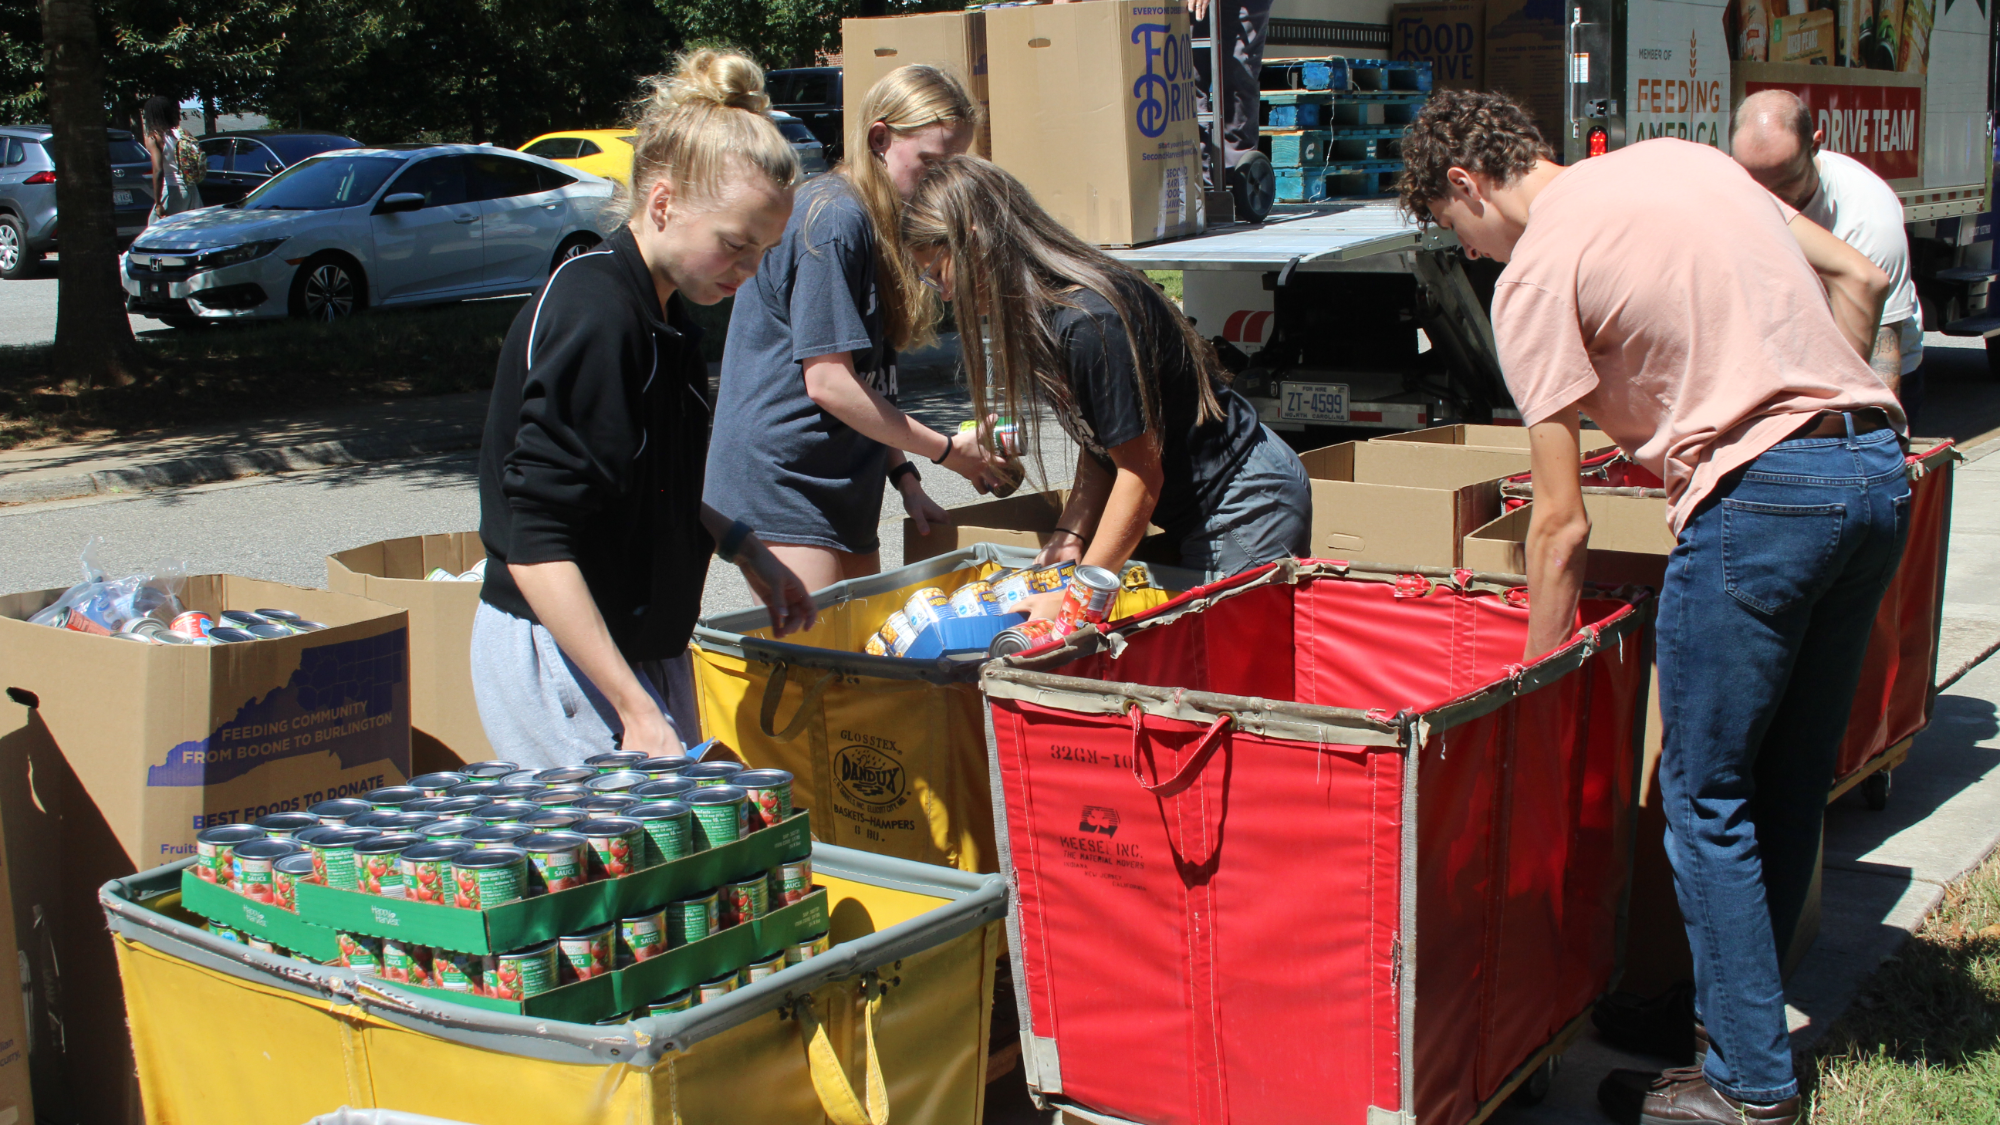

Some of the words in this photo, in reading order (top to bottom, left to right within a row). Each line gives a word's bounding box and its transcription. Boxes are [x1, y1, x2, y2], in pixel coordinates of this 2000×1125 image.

[1397, 17, 1474, 54] FOOD
[1131, 23, 1192, 82] FOOD
[1638, 48, 1662, 61] MEMBER
[1663, 49, 1672, 61] OF
[1133, 73, 1196, 138] DRIVE
[1637, 78, 1720, 113] FEEDING
[1818, 109, 1869, 153] DRIVE
[1872, 109, 1916, 152] TEAM
[1287, 391, 1342, 414] ZT-4599
[221, 719, 288, 742] FEEDING
[291, 700, 368, 729] COMMUNITY
[182, 748, 232, 764] FROM
[236, 738, 290, 759] BOONE
[294, 731, 312, 747] TO
[315, 712, 392, 743] BURLINGTON
[840, 729, 898, 751] GLOSSTEX
[841, 752, 900, 795] DANDUX
[193, 809, 240, 830] BEST
[244, 797, 300, 822] FOODS
[304, 790, 323, 807] TO
[327, 774, 385, 800] DONATE
[833, 803, 915, 830] BASKETS-HAMPERS
[160, 843, 198, 854] Fruits
[1063, 850, 1076, 860] THE
[1080, 853, 1112, 865] MATERIAL
[1116, 859, 1145, 869] MOVERS
[1116, 843, 1144, 859] INC.
[554, 868, 575, 877] SAUCE
[243, 904, 261, 918] Happy
[246, 914, 267, 927] Harvest
[371, 905, 392, 921] Happy
[375, 916, 400, 927] Harvest
